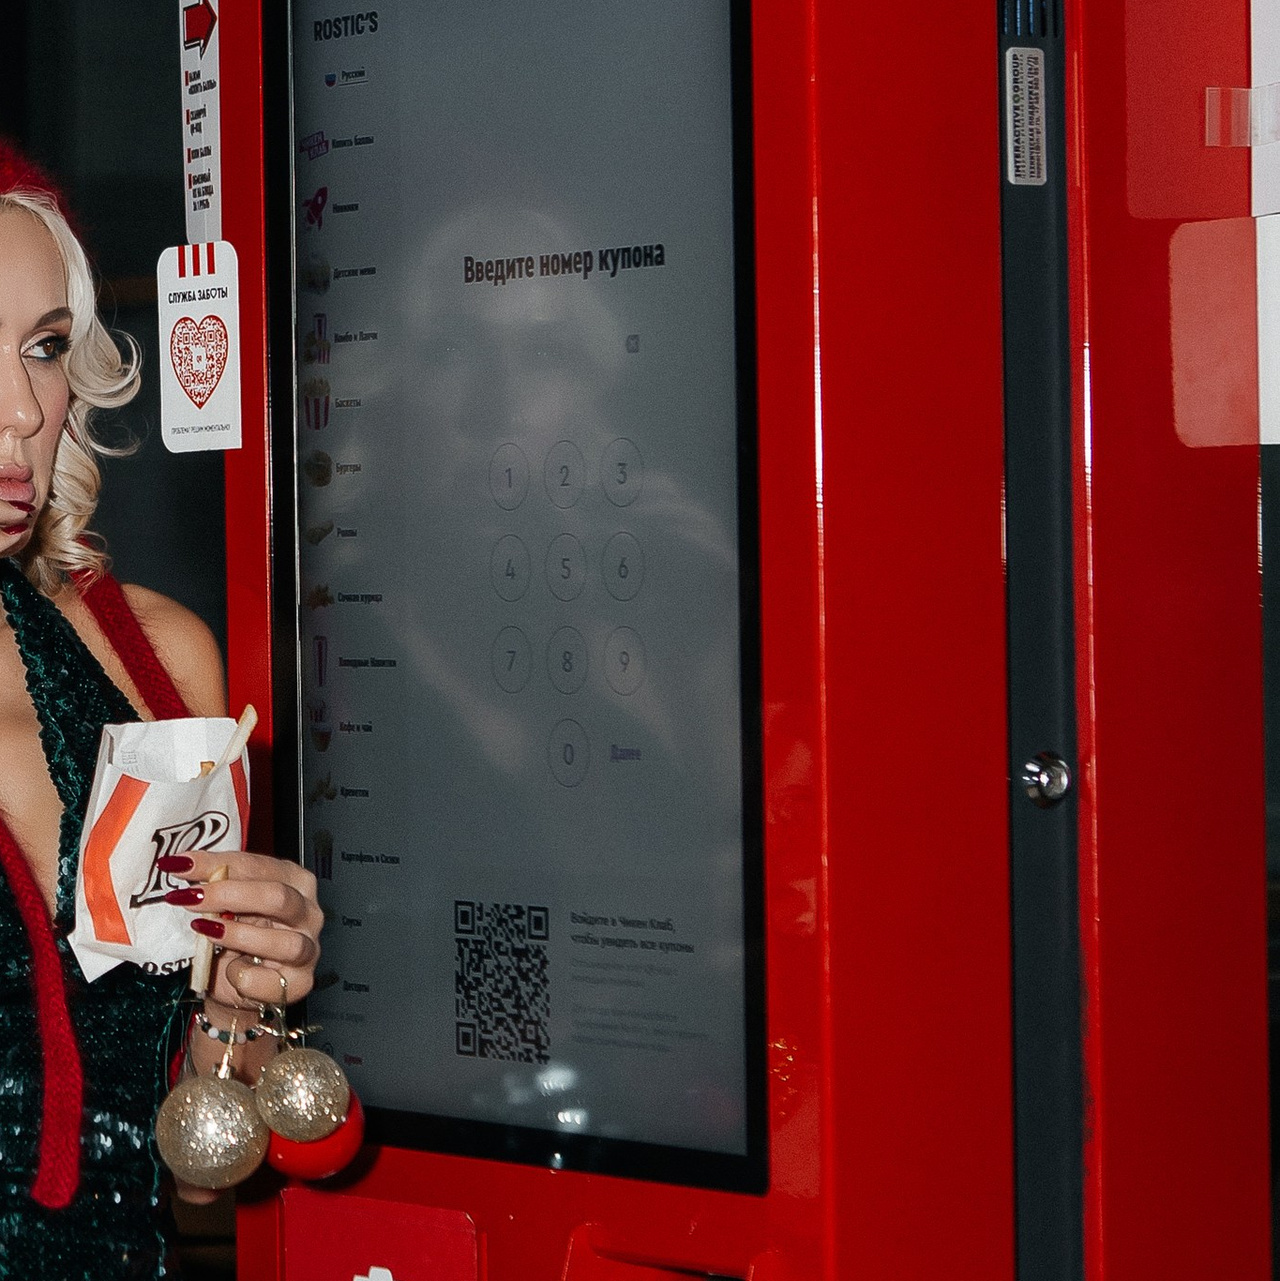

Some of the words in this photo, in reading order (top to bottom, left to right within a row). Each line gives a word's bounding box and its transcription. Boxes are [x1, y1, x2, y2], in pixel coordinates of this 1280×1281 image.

[314, 11, 378, 41] ROSTIC'S
[1012, 54, 1020, 92] GROUP
[1012, 105, 1021, 177] INTERACTIVE
[464, 255, 534, 286] Введите
[540, 250, 593, 279] номер
[598, 243, 665, 278] купона
[168, 290, 196, 304] СЛУЖБА
[198, 287, 228, 301] ЗАБОТЫ
[505, 467, 512, 488] 1
[560, 465, 571, 487] 2
[617, 463, 628, 485] 3
[505, 558, 516, 580] 4
[561, 558, 571, 579] 5
[619, 557, 629, 579] 6
[505, 650, 516, 672] 7
[562, 651, 572, 672] 8
[619, 651, 630, 672] 9
[564, 744, 574, 765] 0
